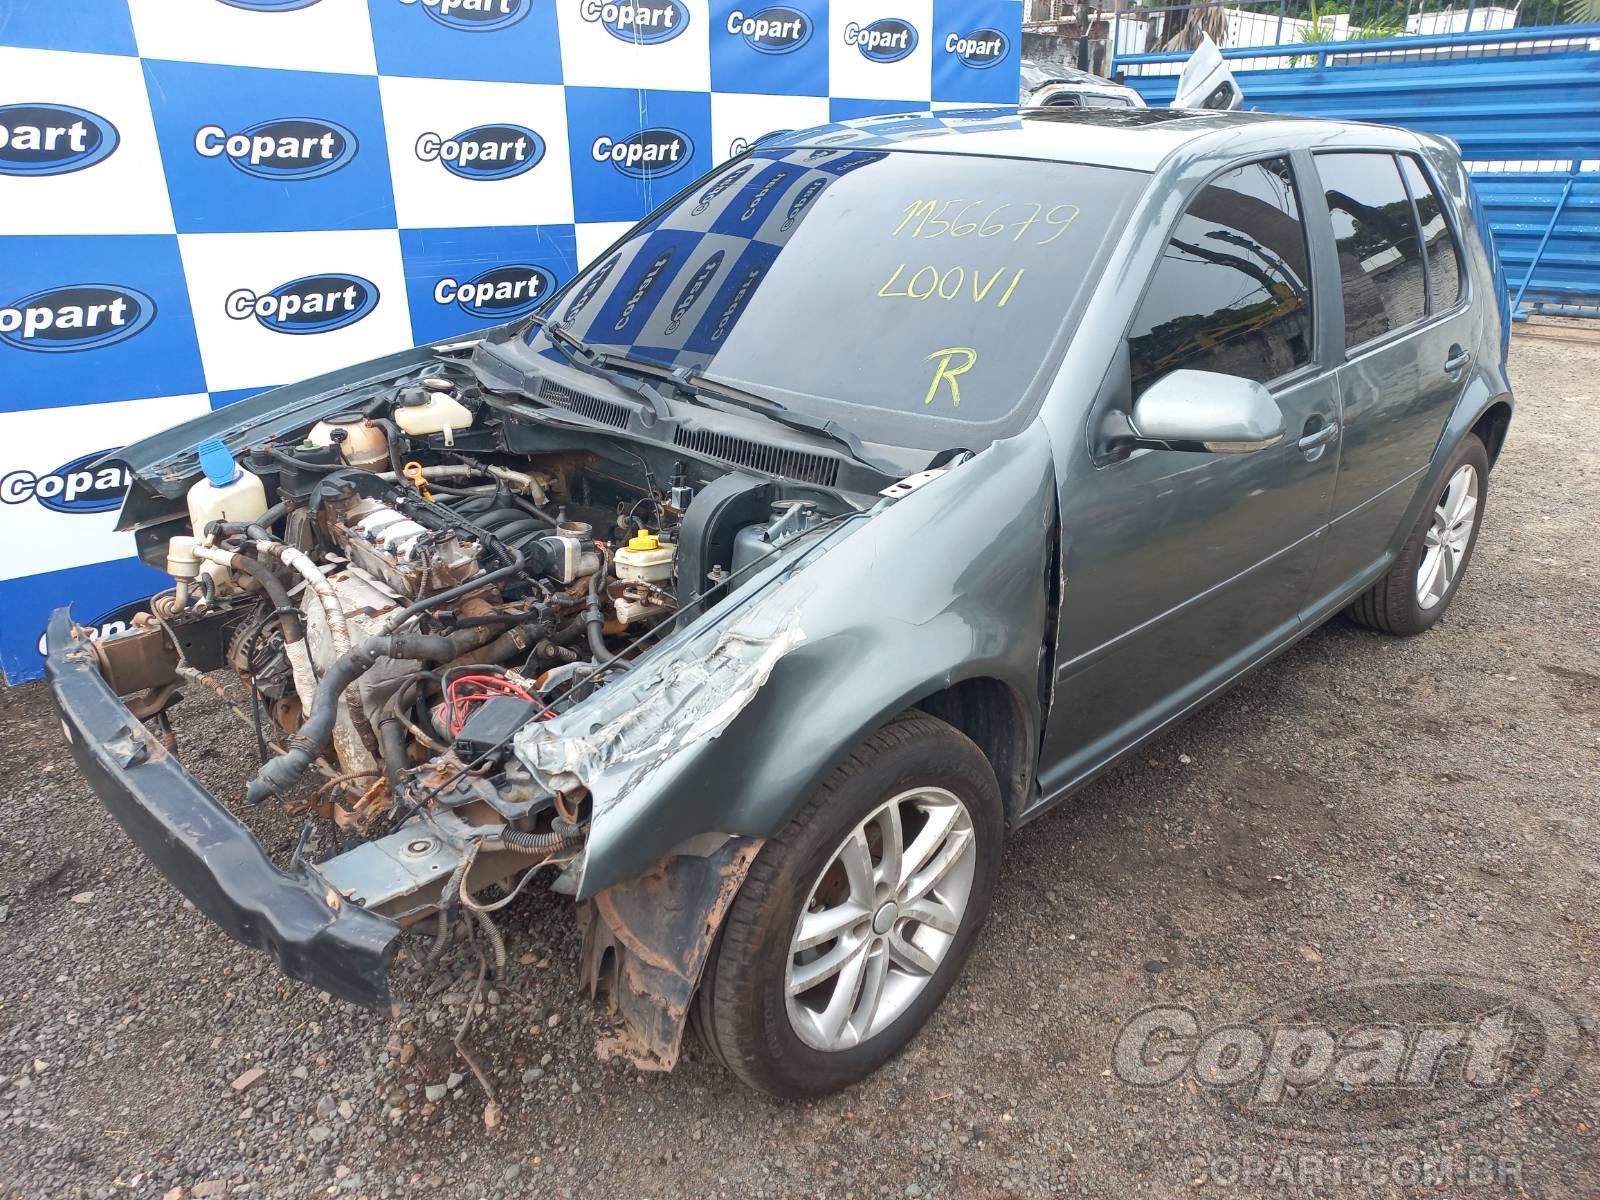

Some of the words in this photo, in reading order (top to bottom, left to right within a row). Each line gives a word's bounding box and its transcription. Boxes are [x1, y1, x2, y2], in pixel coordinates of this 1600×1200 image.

[581, 0, 674, 29] Copart
[727, 10, 802, 41] Copart
[844, 22, 908, 50] Copart
[945, 33, 1001, 58] Copart
[194, 125, 335, 165] Copart
[416, 132, 527, 163] Copart
[592, 136, 680, 165] Copart
[227, 286, 356, 322] Copart
[434, 273, 539, 307] Copart
[921, 347, 977, 407] R
